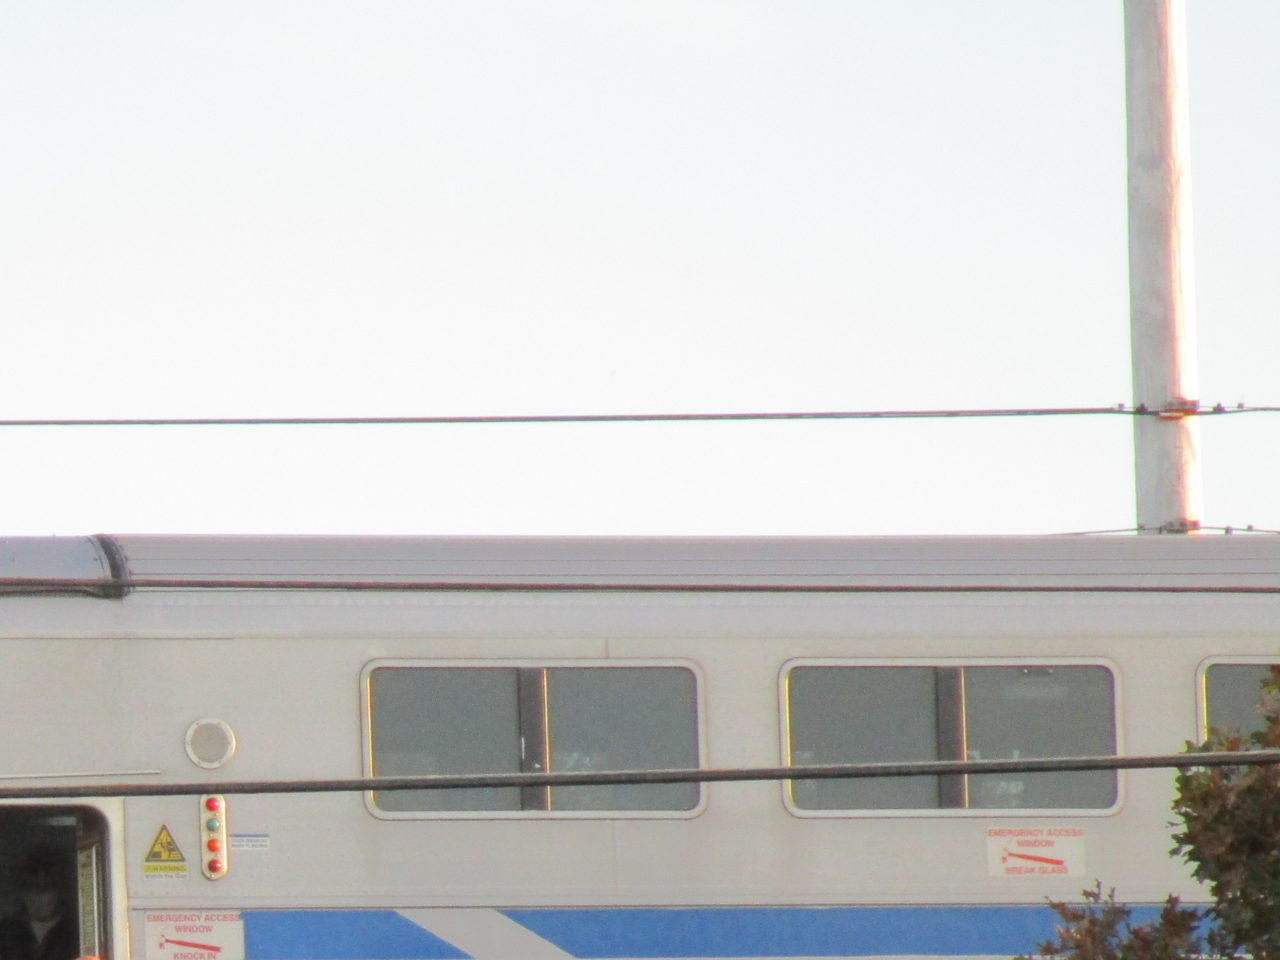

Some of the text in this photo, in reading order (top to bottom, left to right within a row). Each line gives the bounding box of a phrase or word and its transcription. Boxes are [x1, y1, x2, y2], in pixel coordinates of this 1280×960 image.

[988, 829, 1083, 837] EMERGENCY ACCESS
[1017, 840, 1054, 848] WINDOW
[147, 914, 241, 922] EMERGENCY ACCESS
[175, 925, 213, 933] WINDOW
[173, 952, 216, 960] KNOCK IN
